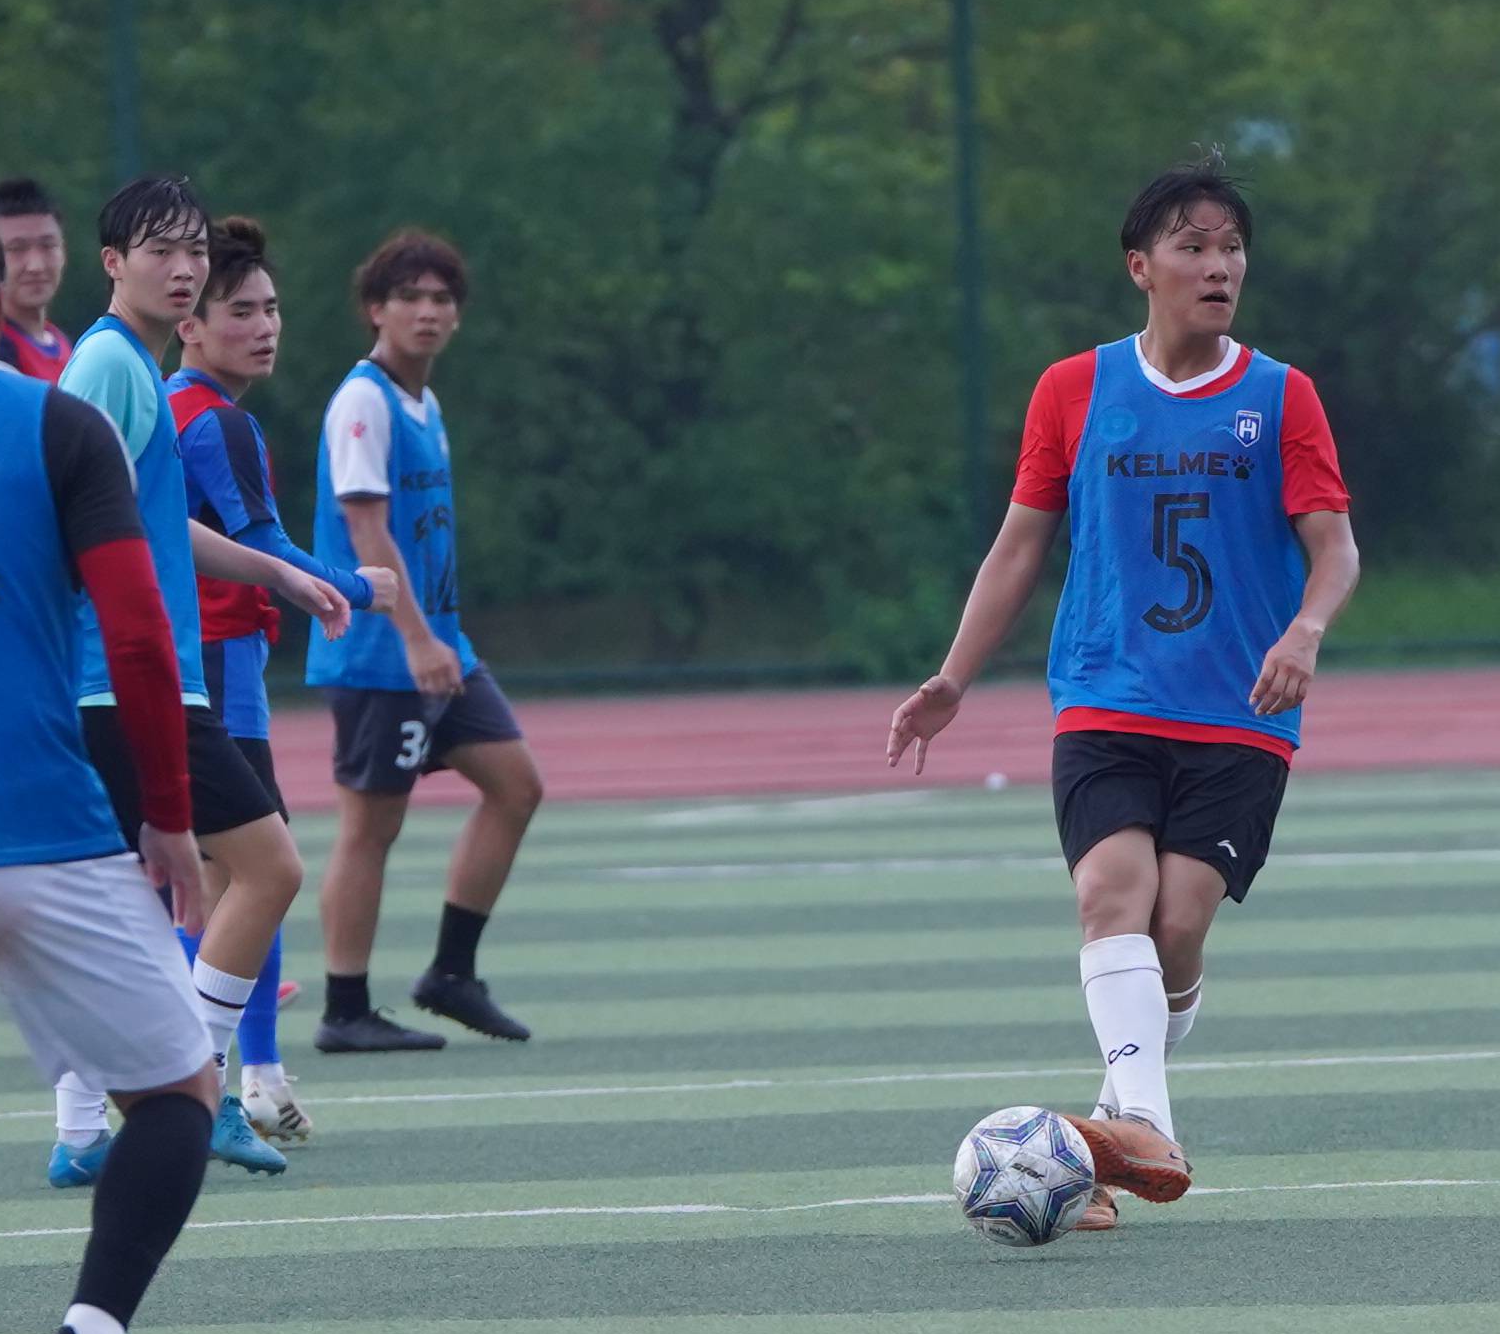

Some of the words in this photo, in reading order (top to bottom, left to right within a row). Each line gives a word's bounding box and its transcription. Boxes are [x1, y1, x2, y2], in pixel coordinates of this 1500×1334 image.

[1107, 452, 1229, 478] KELME
[1142, 492, 1213, 634] 5
[394, 720, 431, 770] 3
